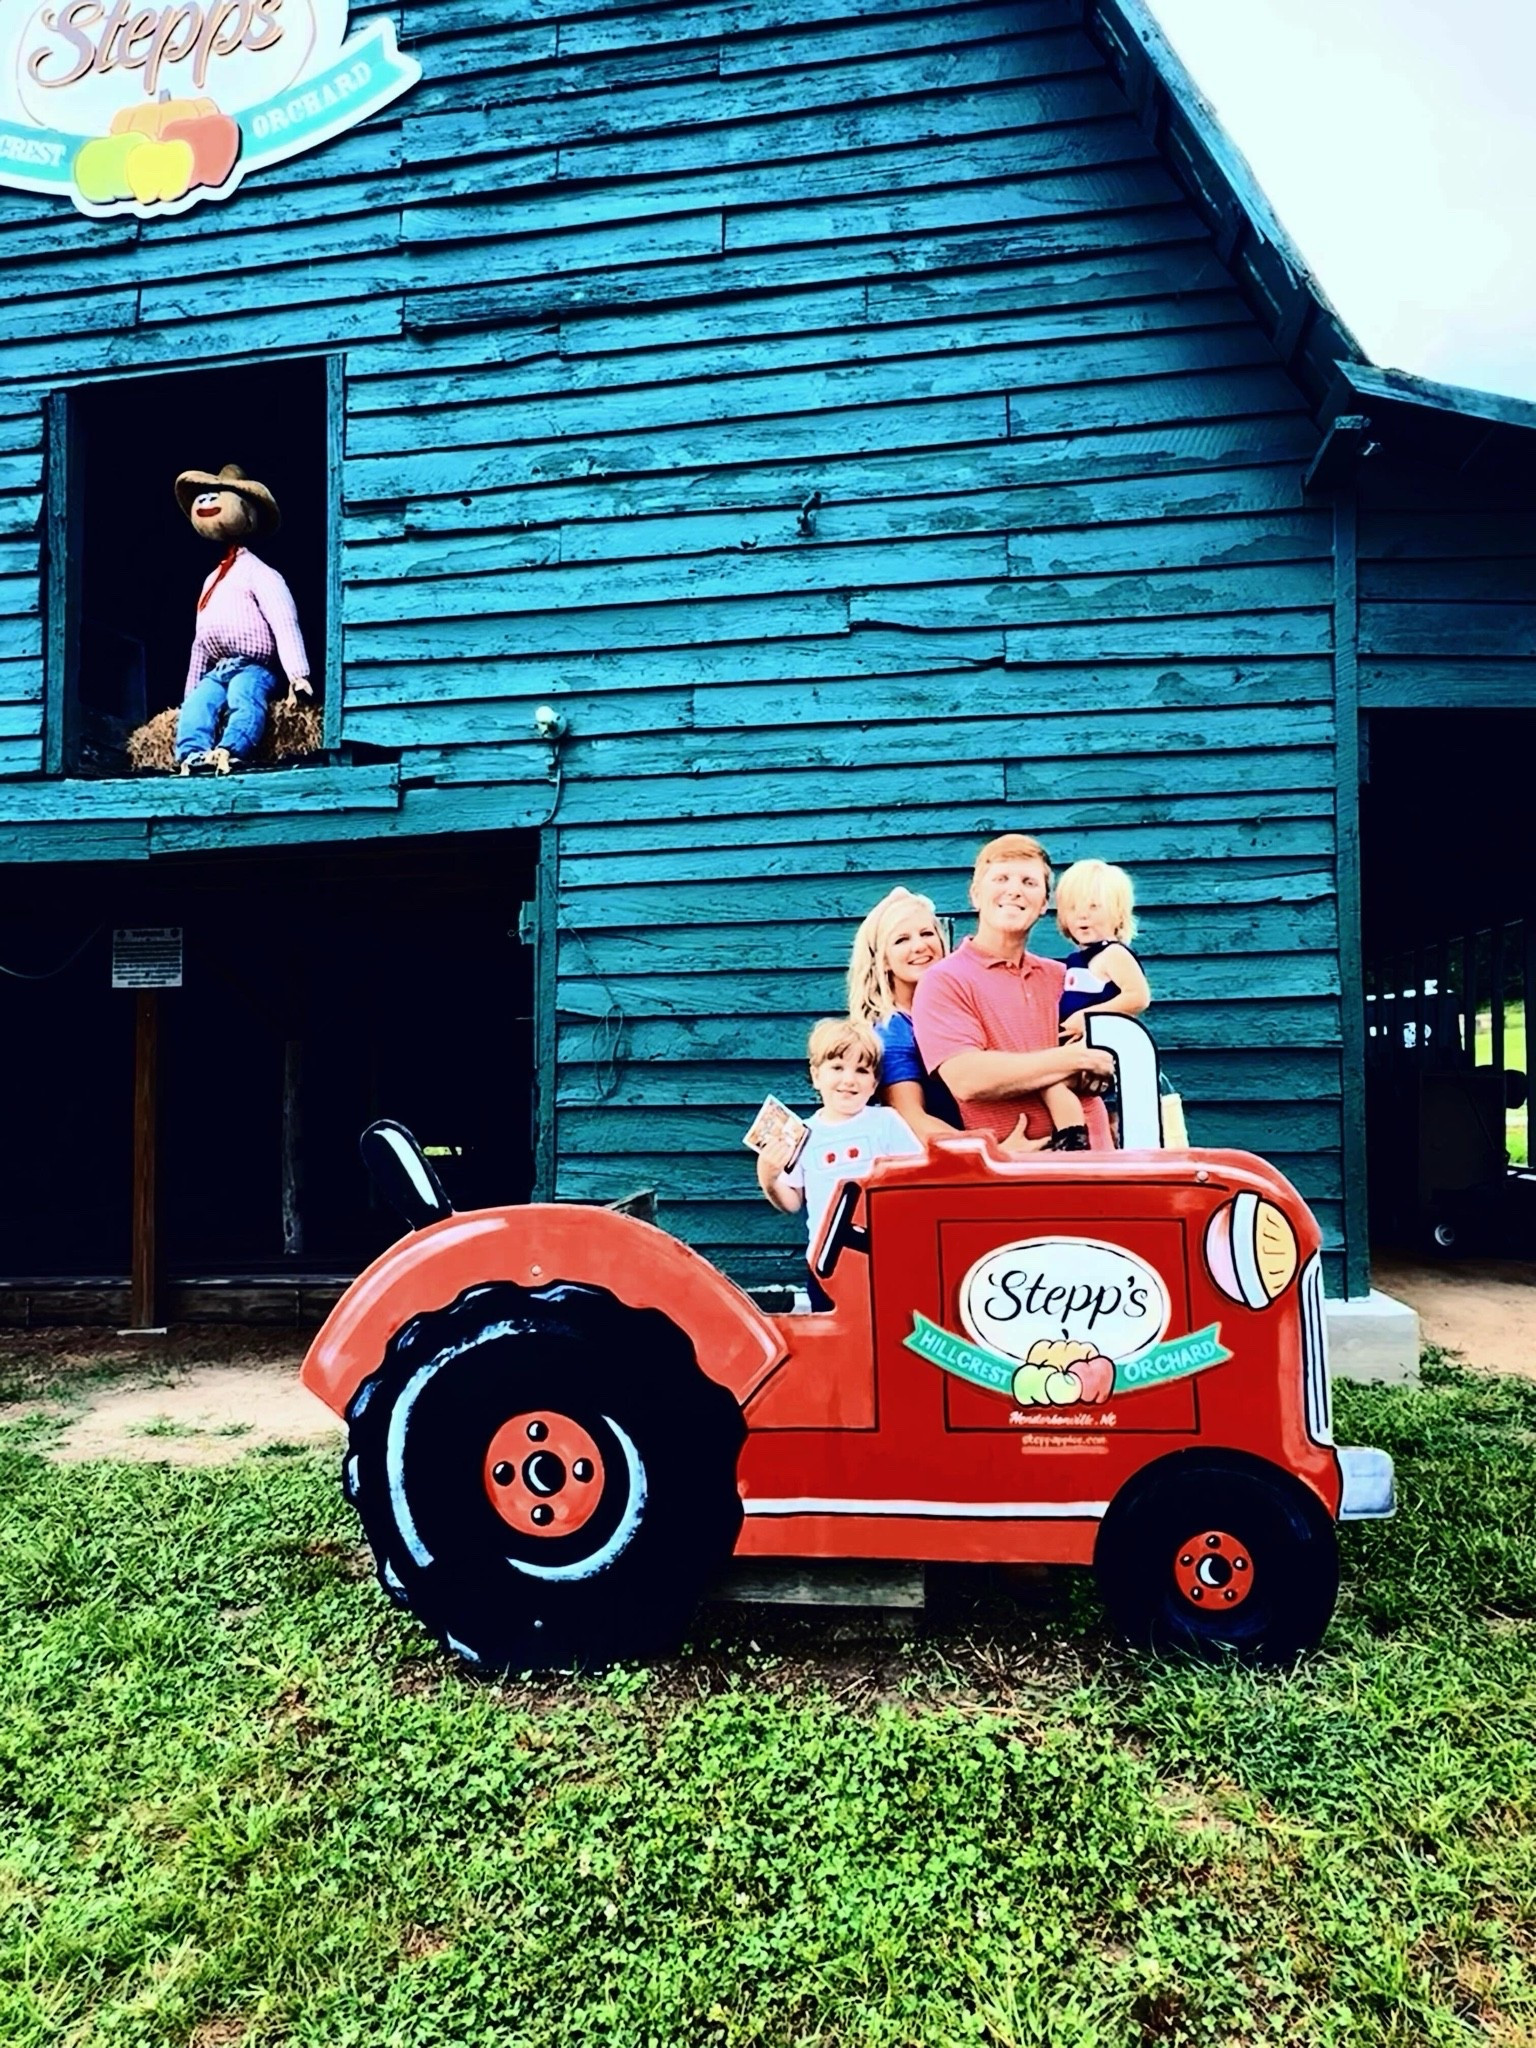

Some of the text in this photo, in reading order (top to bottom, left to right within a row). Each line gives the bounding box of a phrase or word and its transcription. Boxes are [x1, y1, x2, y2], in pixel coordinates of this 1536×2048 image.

[251, 61, 372, 140] ORCHARD
[984, 1270, 1149, 1330] Stepp's
[919, 1329, 1217, 1386] HILLCREST ORCHARD
